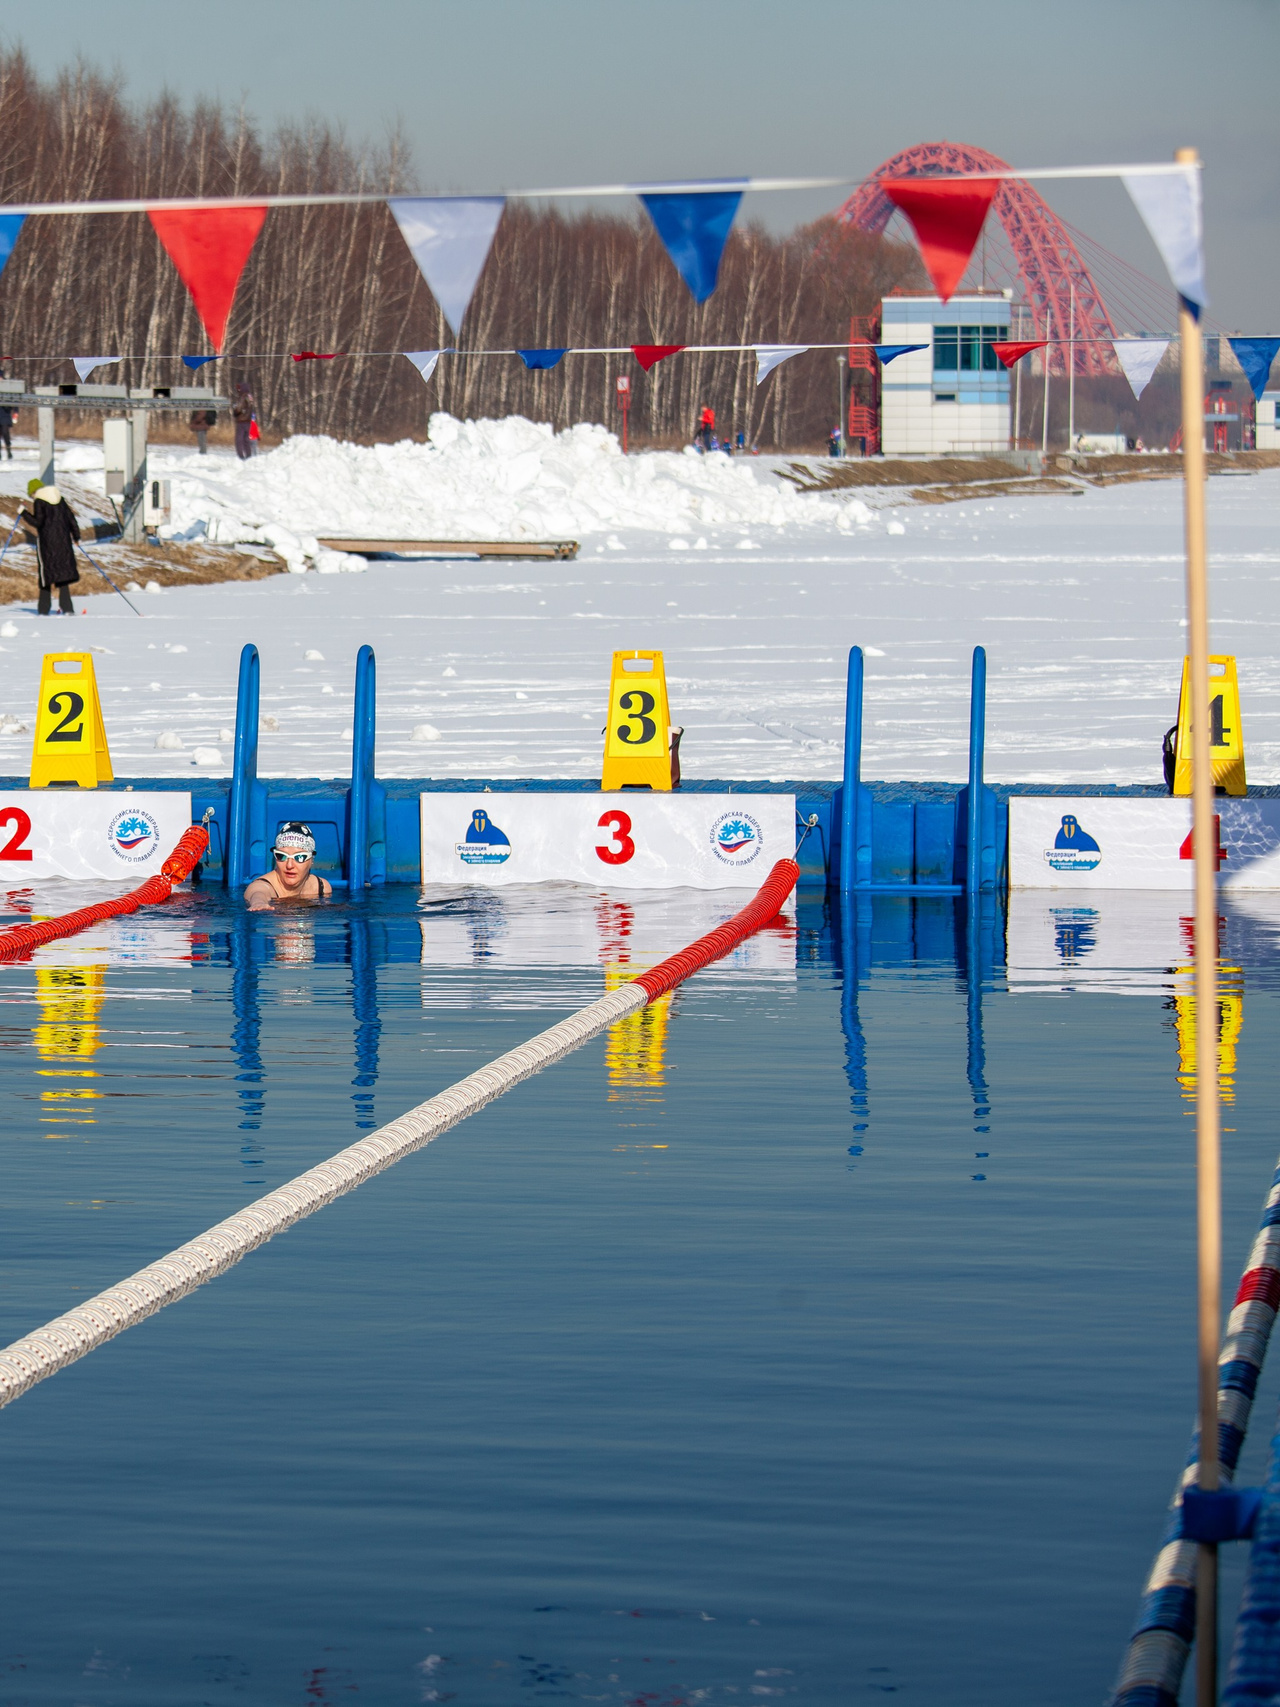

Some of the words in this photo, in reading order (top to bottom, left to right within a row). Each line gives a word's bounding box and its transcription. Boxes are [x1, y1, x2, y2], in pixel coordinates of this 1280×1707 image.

[46, 692, 83, 742] 2
[618, 691, 655, 744] 3
[108, 809, 140, 840] ВСЕРОССИЙСКАЯ
[141, 811, 160, 841] ФЕДЕРАЦИЯ
[595, 809, 636, 865] 3
[710, 811, 743, 843] ВСЕРОССИЙСКАЯ
[744, 813, 763, 845] ФЕДЕРАЦИЯ
[110, 843, 132, 862] ЗИМНЕГО
[133, 842, 158, 862] ПЛАВАНИЯ
[712, 847, 735, 866] ЗИМНЕГО
[736, 846, 761, 867] ПЛАВАНИЯ
